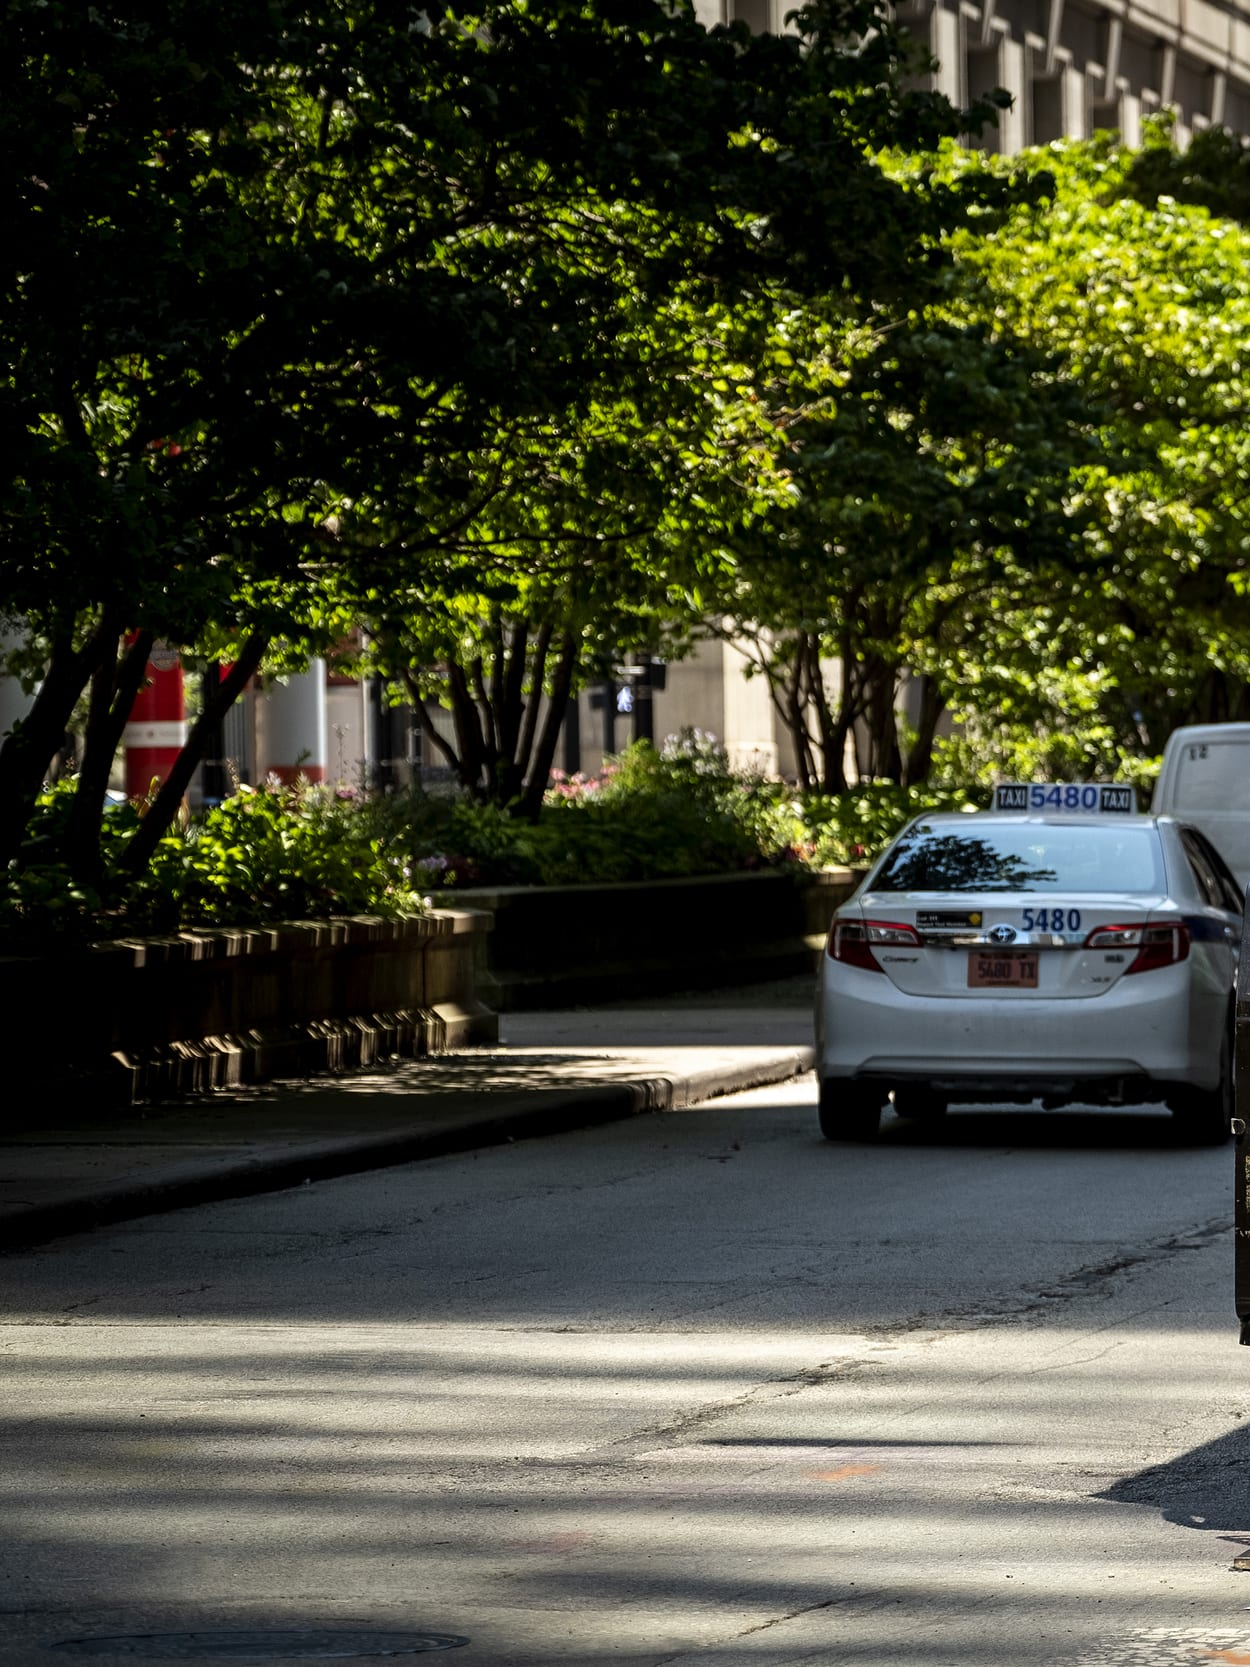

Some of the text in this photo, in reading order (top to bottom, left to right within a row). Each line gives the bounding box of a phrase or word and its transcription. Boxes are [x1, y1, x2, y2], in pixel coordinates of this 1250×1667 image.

[998, 785, 1130, 809] TAXI 5480 TAXI
[1021, 907, 1082, 933] 5480
